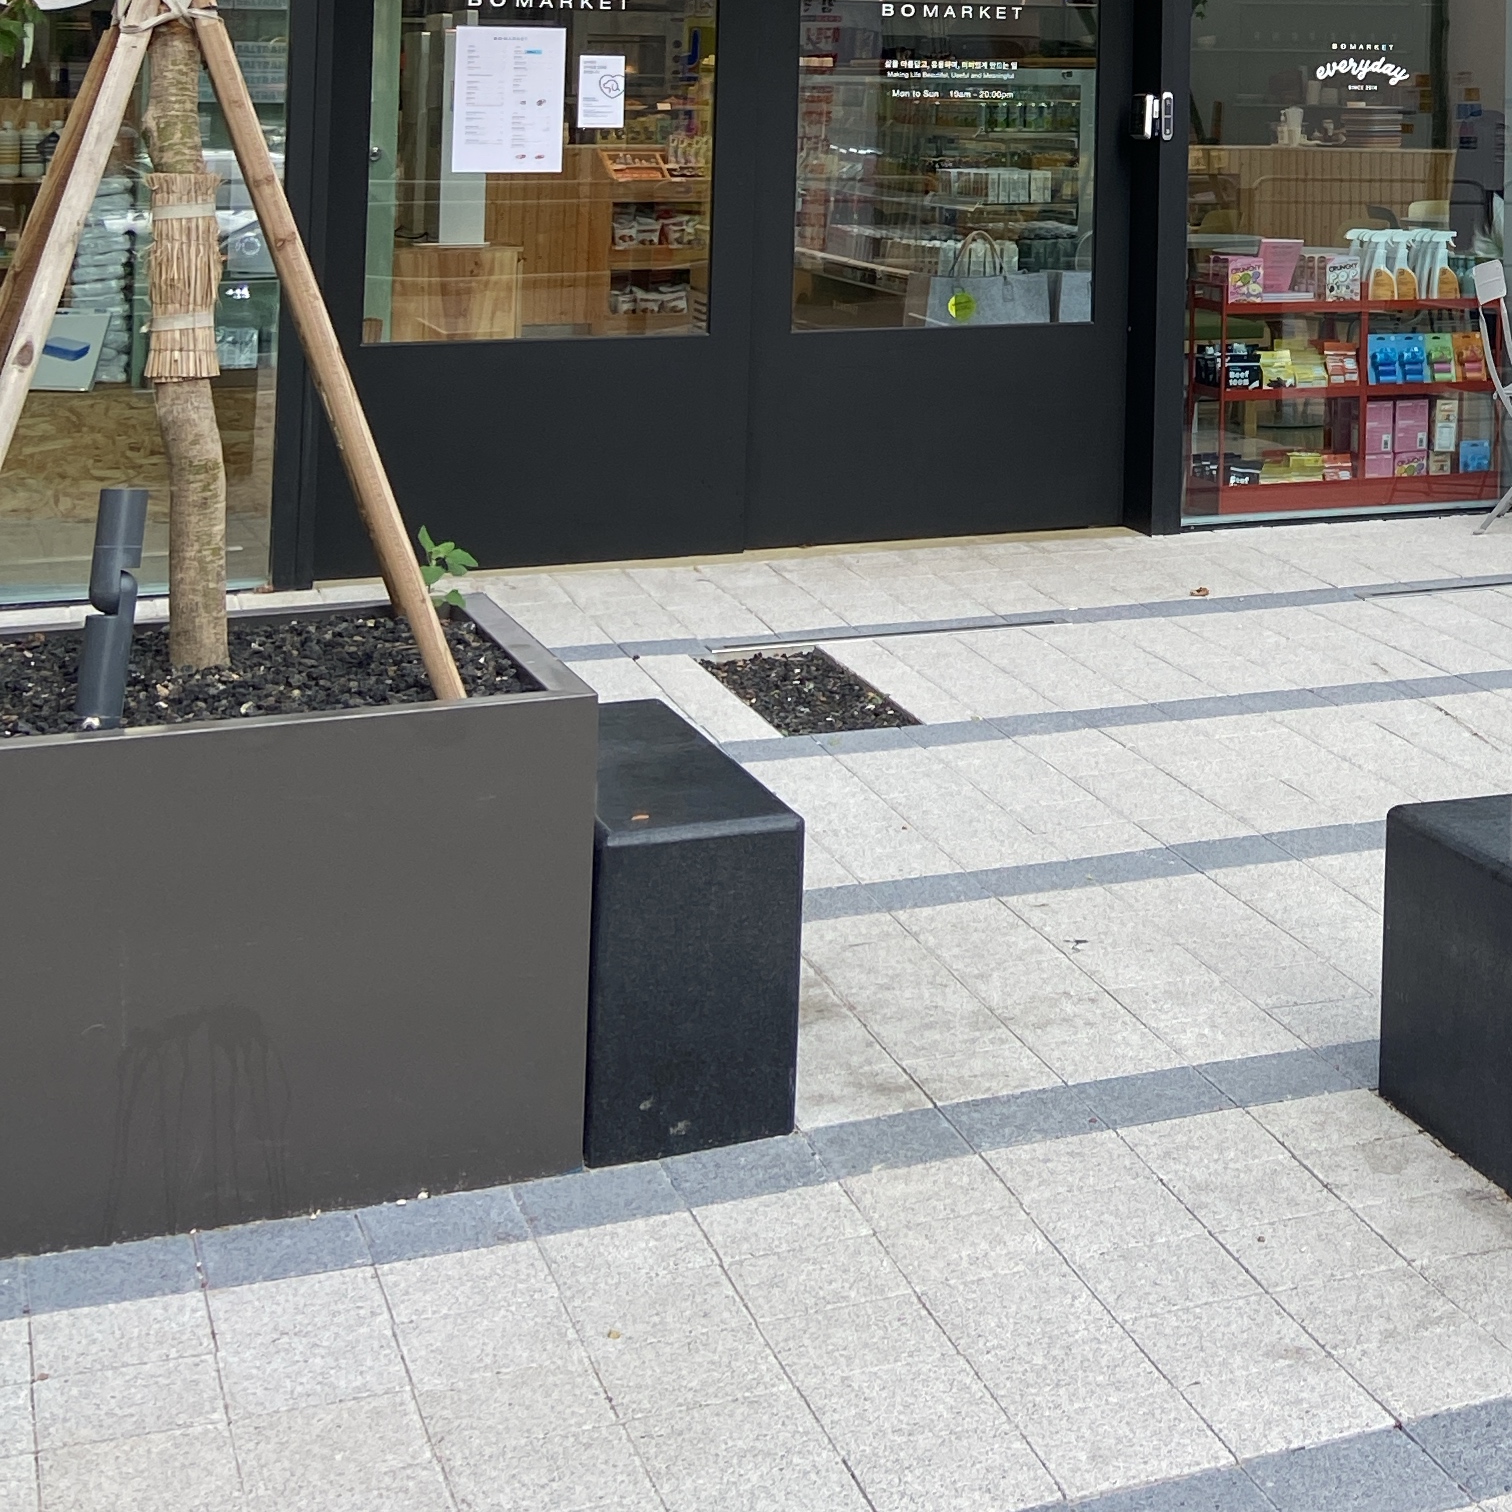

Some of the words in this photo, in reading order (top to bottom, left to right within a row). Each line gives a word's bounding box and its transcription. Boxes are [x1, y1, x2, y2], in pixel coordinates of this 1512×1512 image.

[881, 3, 1023, 20] BOMARKET
[1316, 57, 1410, 86] everyday
[891, 89, 910, 98] Mon
[912, 90, 921, 98] to
[923, 90, 940, 98] Sun
[1228, 370, 1250, 380] Beef
